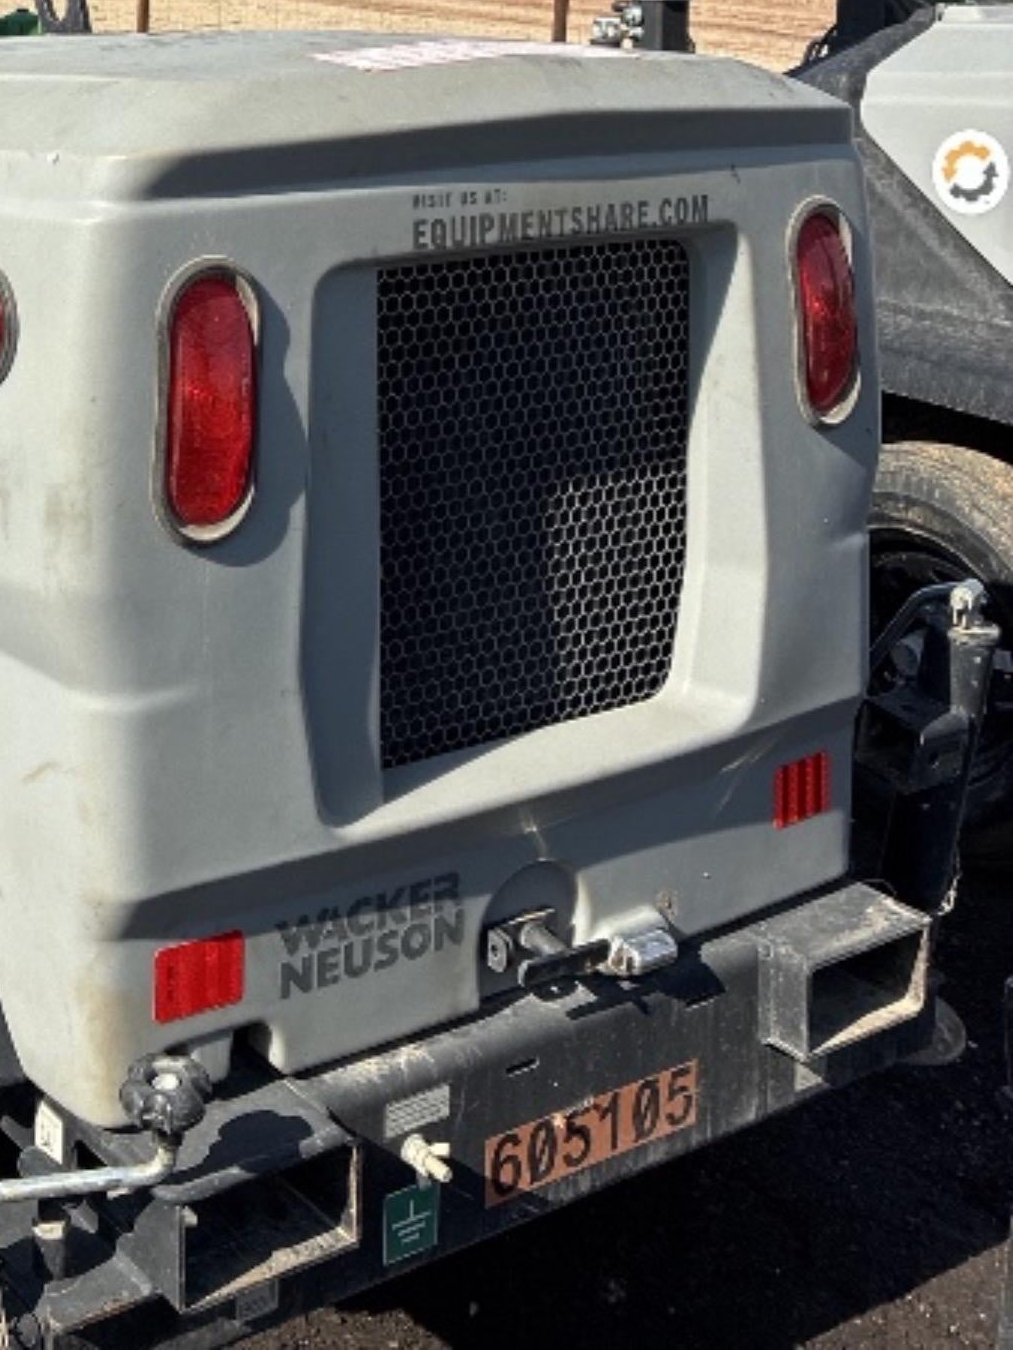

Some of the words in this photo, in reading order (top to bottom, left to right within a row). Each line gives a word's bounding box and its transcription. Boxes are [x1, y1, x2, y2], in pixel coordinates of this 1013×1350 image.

[412, 194, 709, 250] EQUIPMENTSHARE.COM
[274, 871, 461, 955] WACKER
[279, 908, 465, 999] NEUSON
[490, 1066, 694, 1197] 605105
